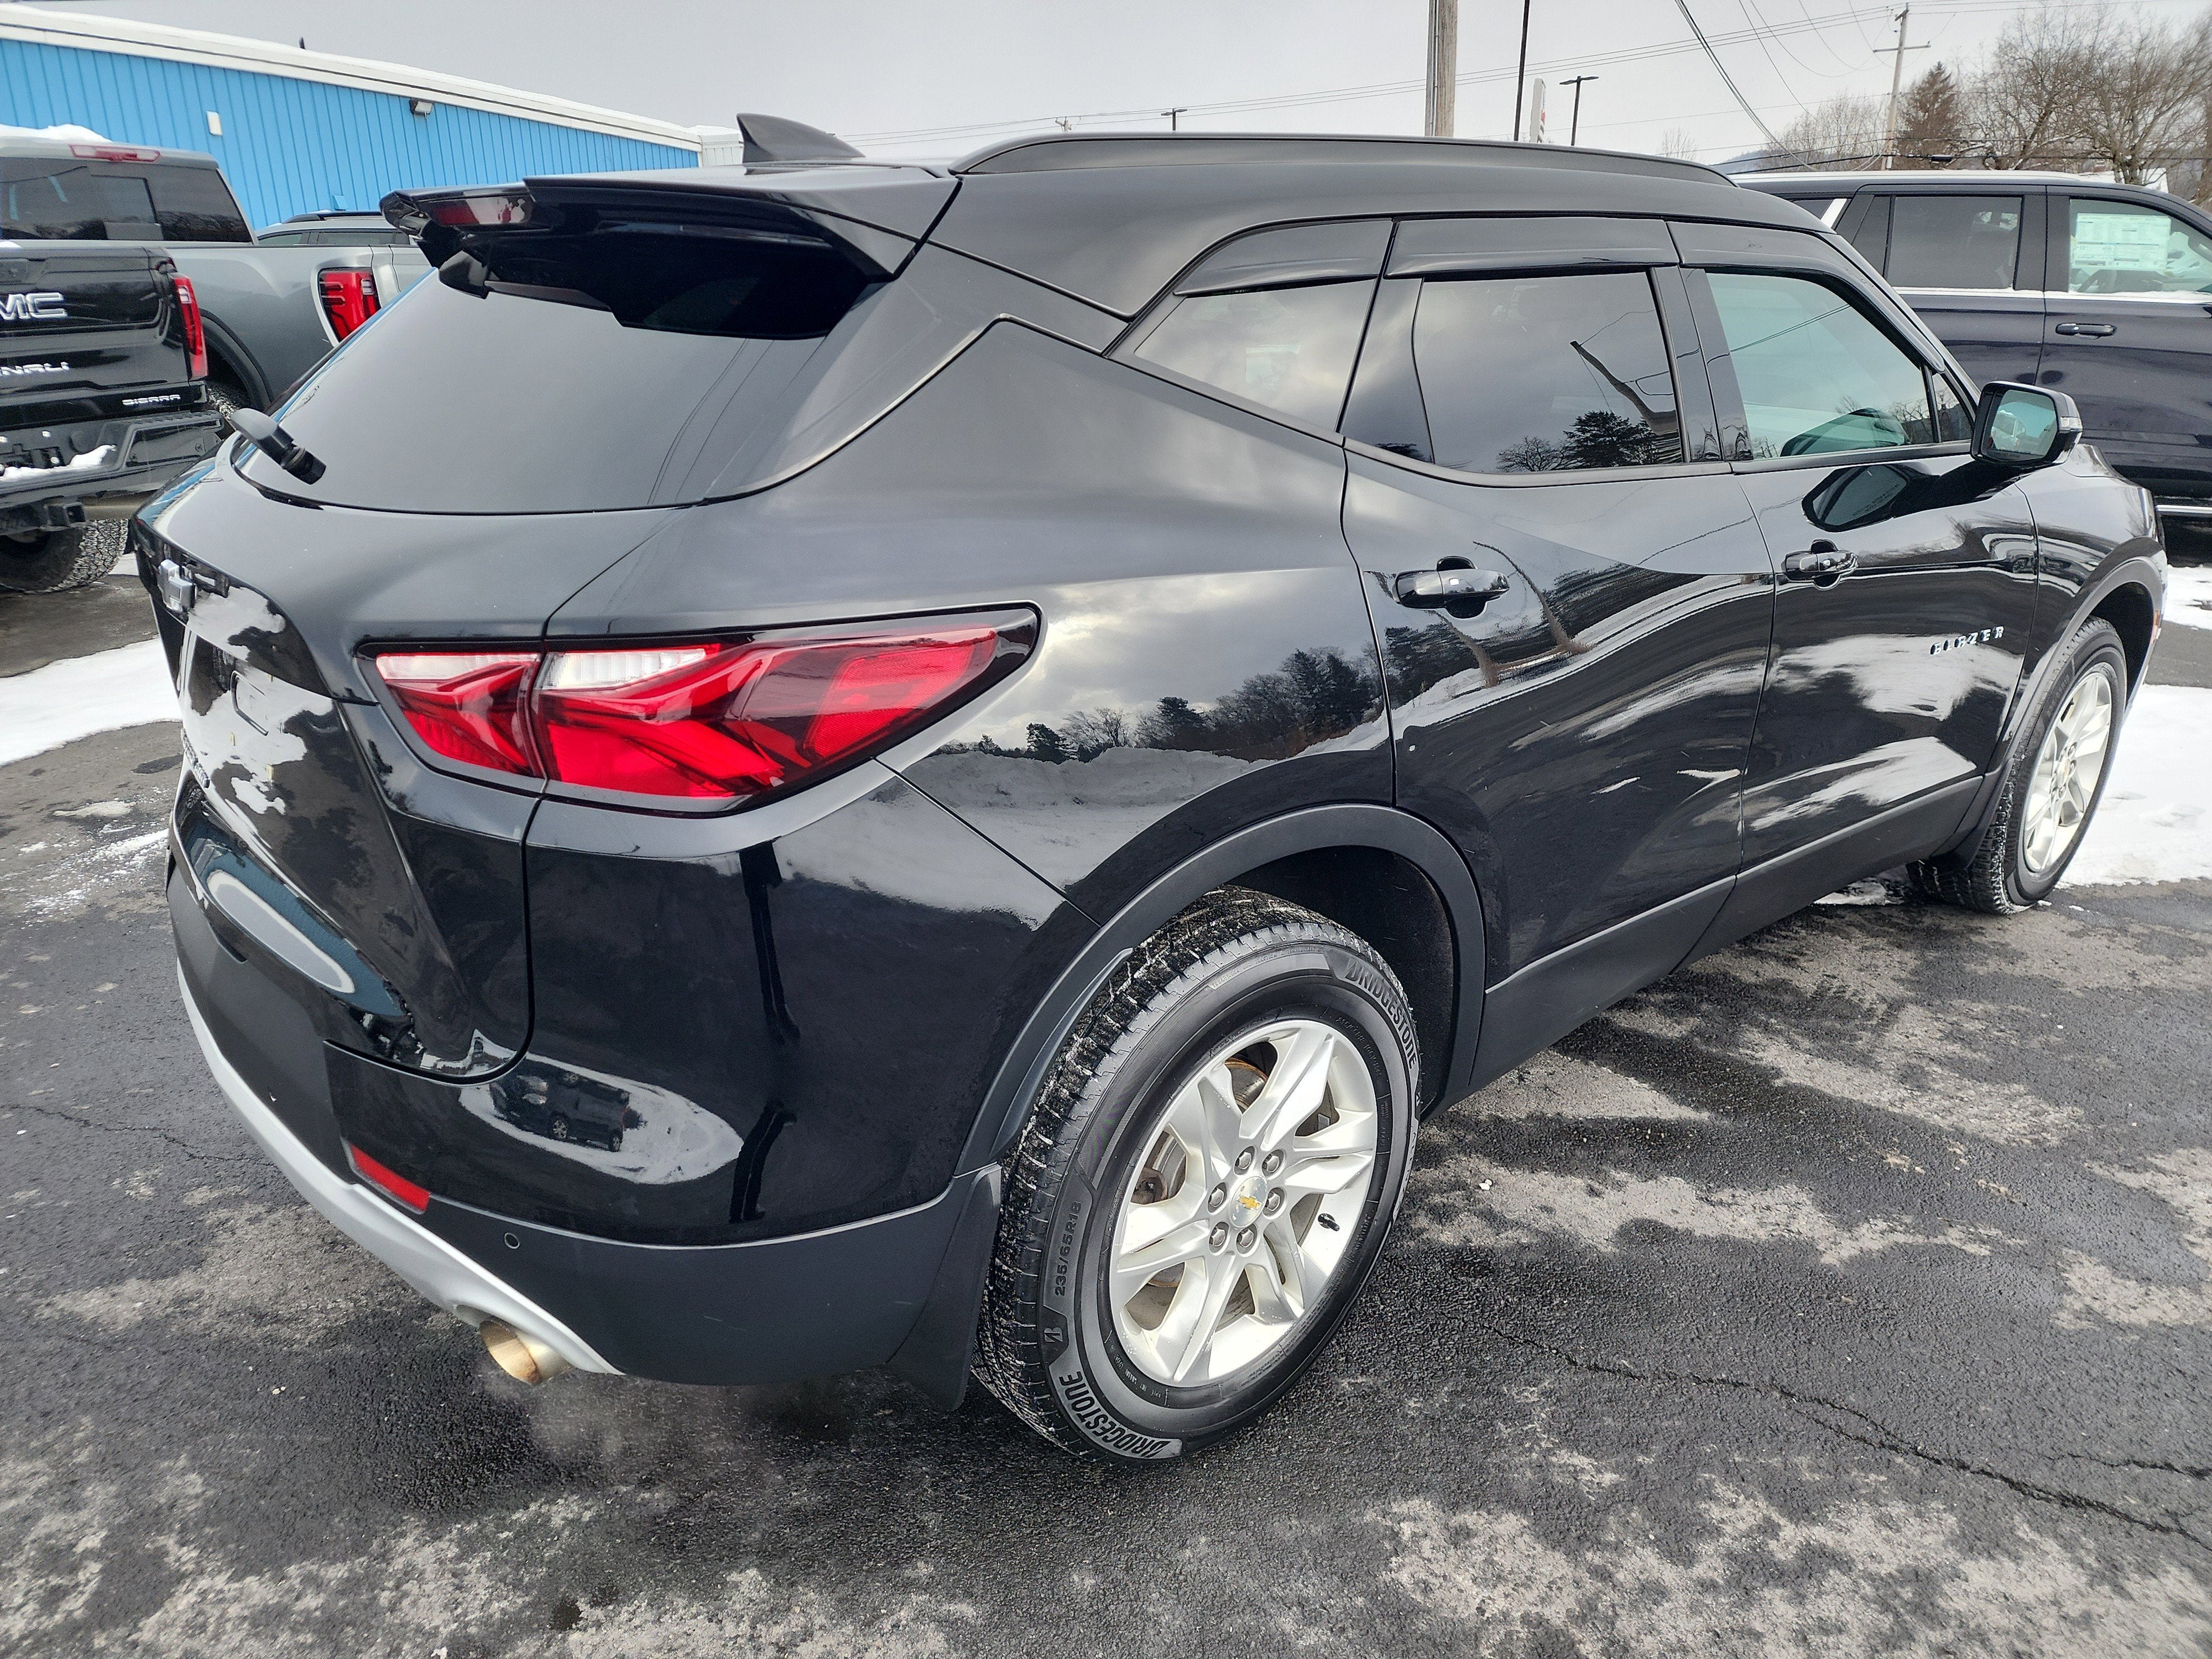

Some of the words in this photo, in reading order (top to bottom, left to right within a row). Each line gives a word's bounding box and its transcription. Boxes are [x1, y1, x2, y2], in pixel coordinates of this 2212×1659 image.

[0, 362, 70, 376] NALI
[122, 394, 181, 405] SIERRA
[1930, 626, 2004, 655] BLAZER
[1344, 957, 1417, 1070] BRIDGESTONE
[1055, 1201, 1082, 1296] 235/65R18
[1058, 1371, 1171, 1458] BRIDGESTONE
